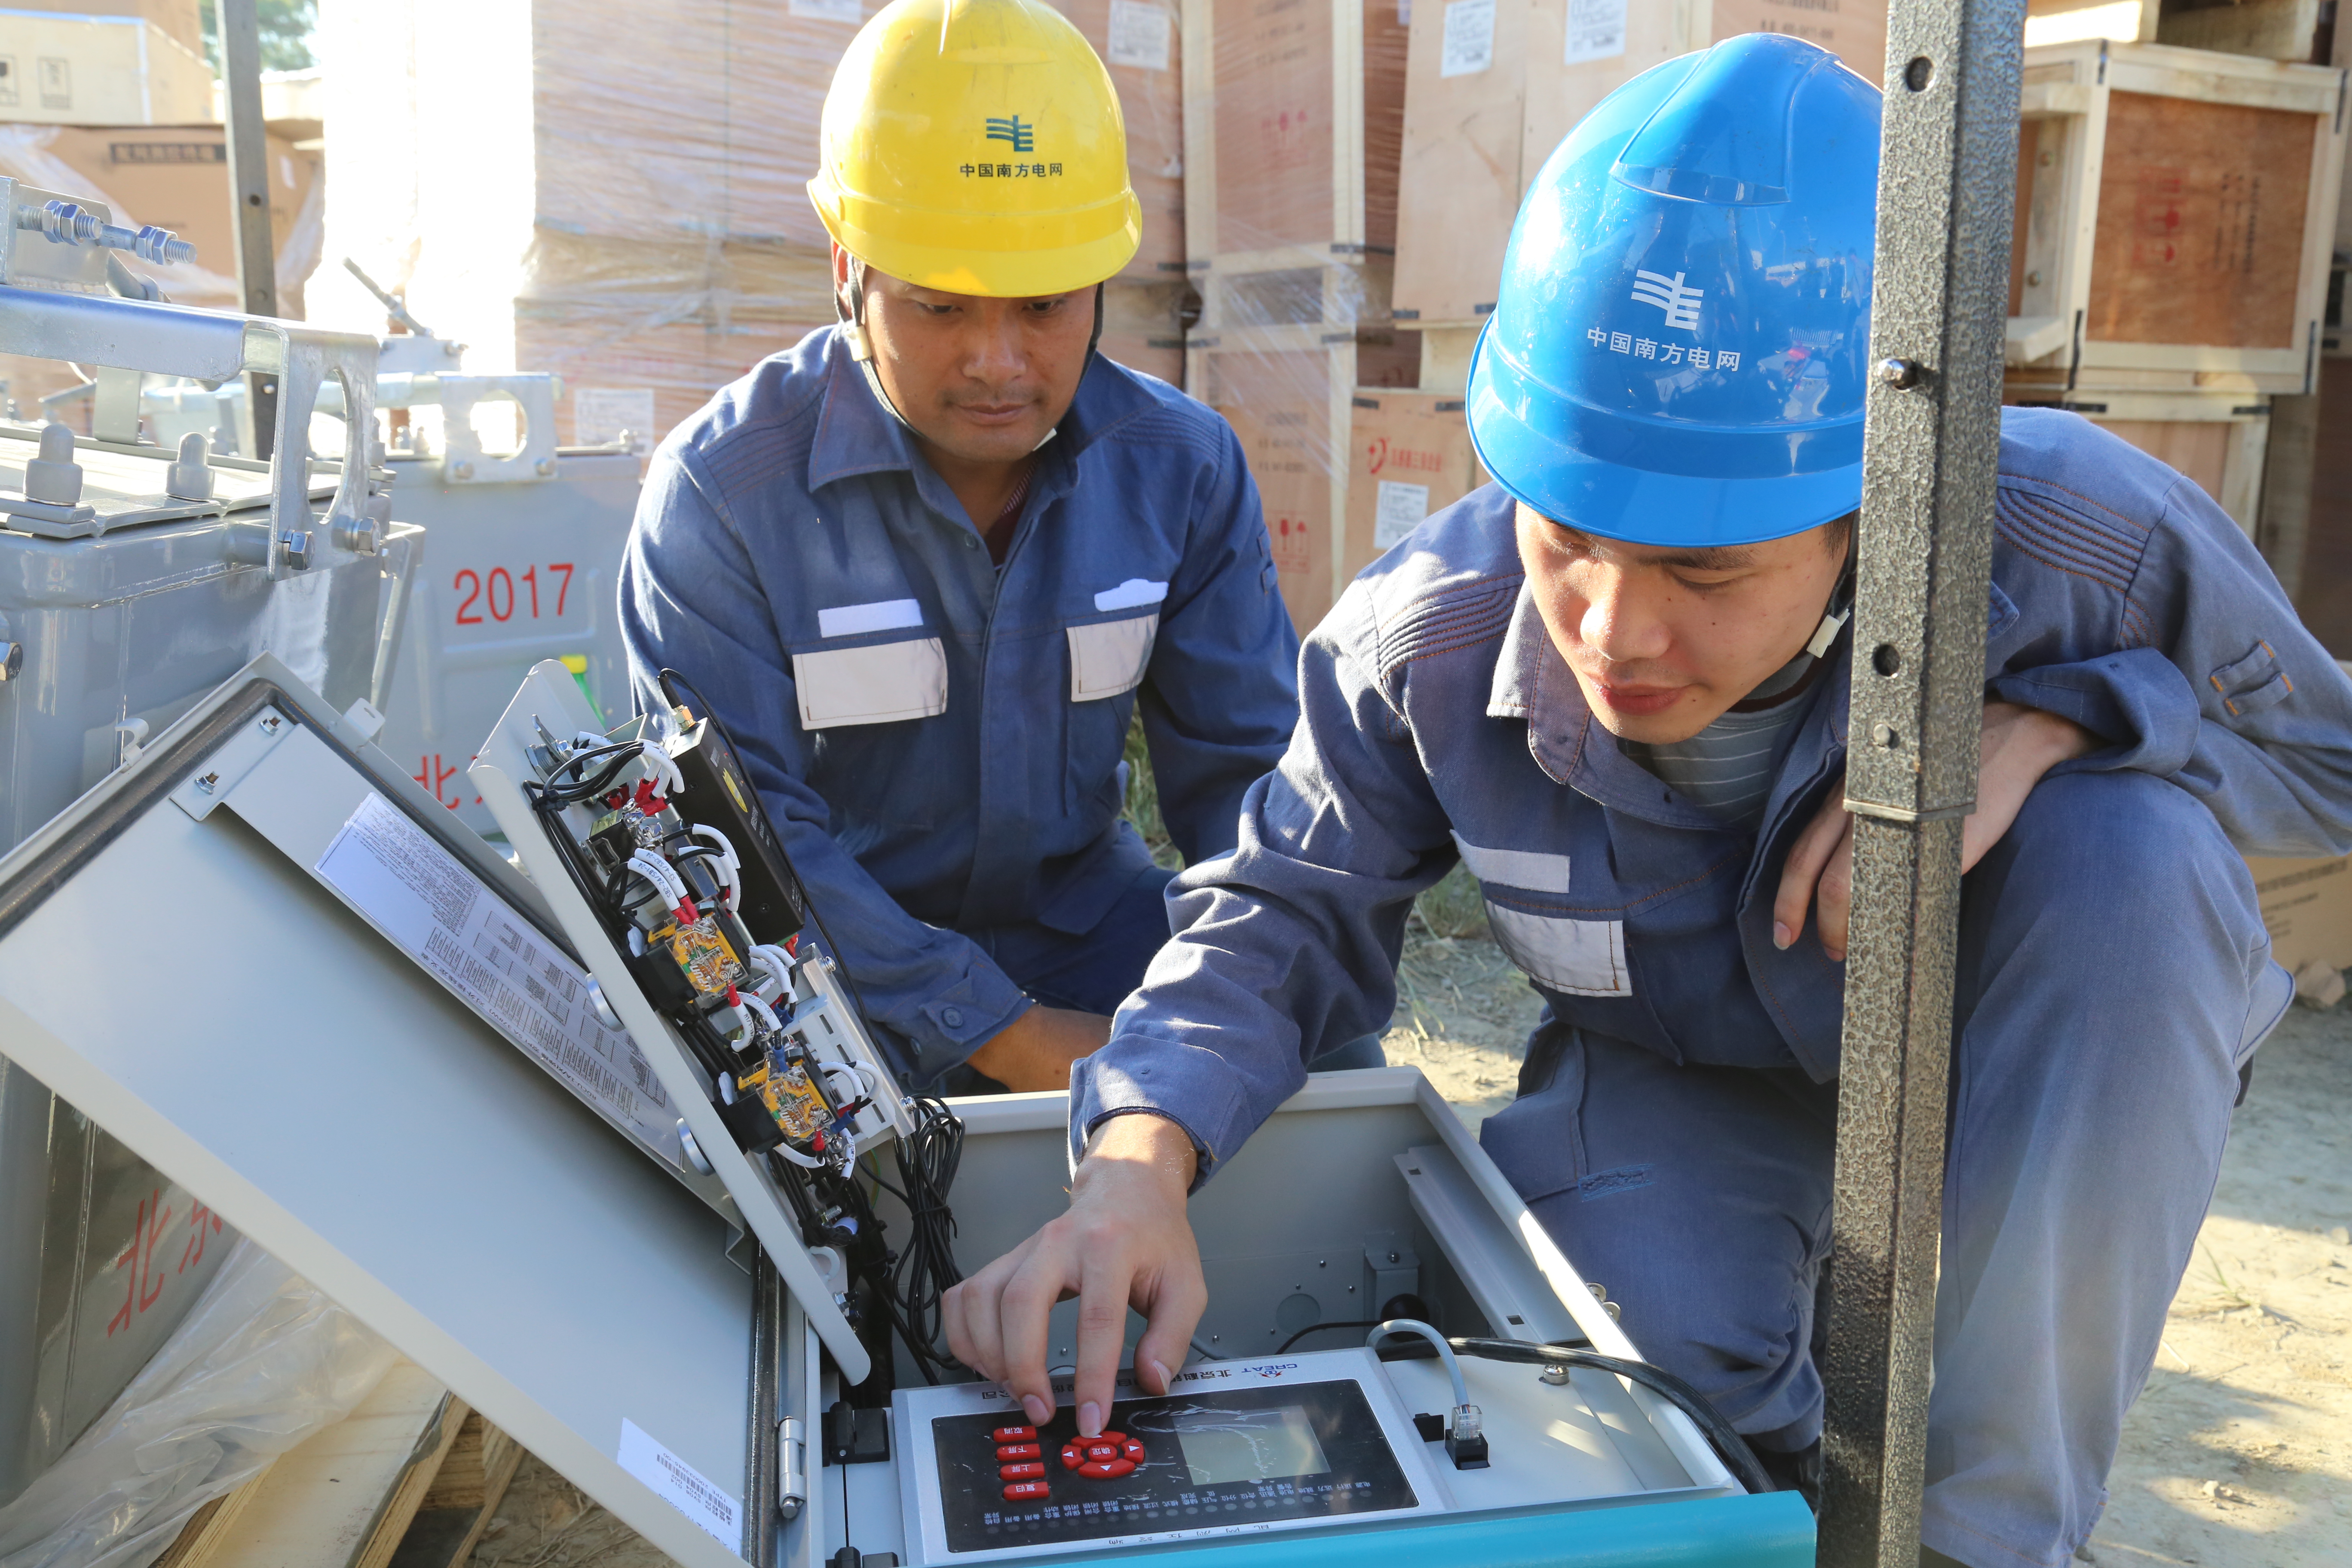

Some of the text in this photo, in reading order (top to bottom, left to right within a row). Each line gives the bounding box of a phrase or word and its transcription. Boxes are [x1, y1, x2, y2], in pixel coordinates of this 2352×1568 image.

[960, 162, 1063, 178] 中国南方电网
[1587, 327, 1741, 373] 中国南方电网
[454, 563, 575, 625] 2017
[646, 852, 676, 881] S3-4/SB2-24
[638, 863, 672, 898] SB2-24/SB1-24
[1241, 1363, 1298, 1375] CREAT
[1004, 1427, 1023, 1435] 取消
[1008, 1446, 1026, 1454] 下屏
[1092, 1447, 1112, 1456] 确定
[1011, 1464, 1030, 1473] 上屏
[1015, 1484, 1035, 1493] 复归
[1004, 1515, 1021, 1523] 备用
